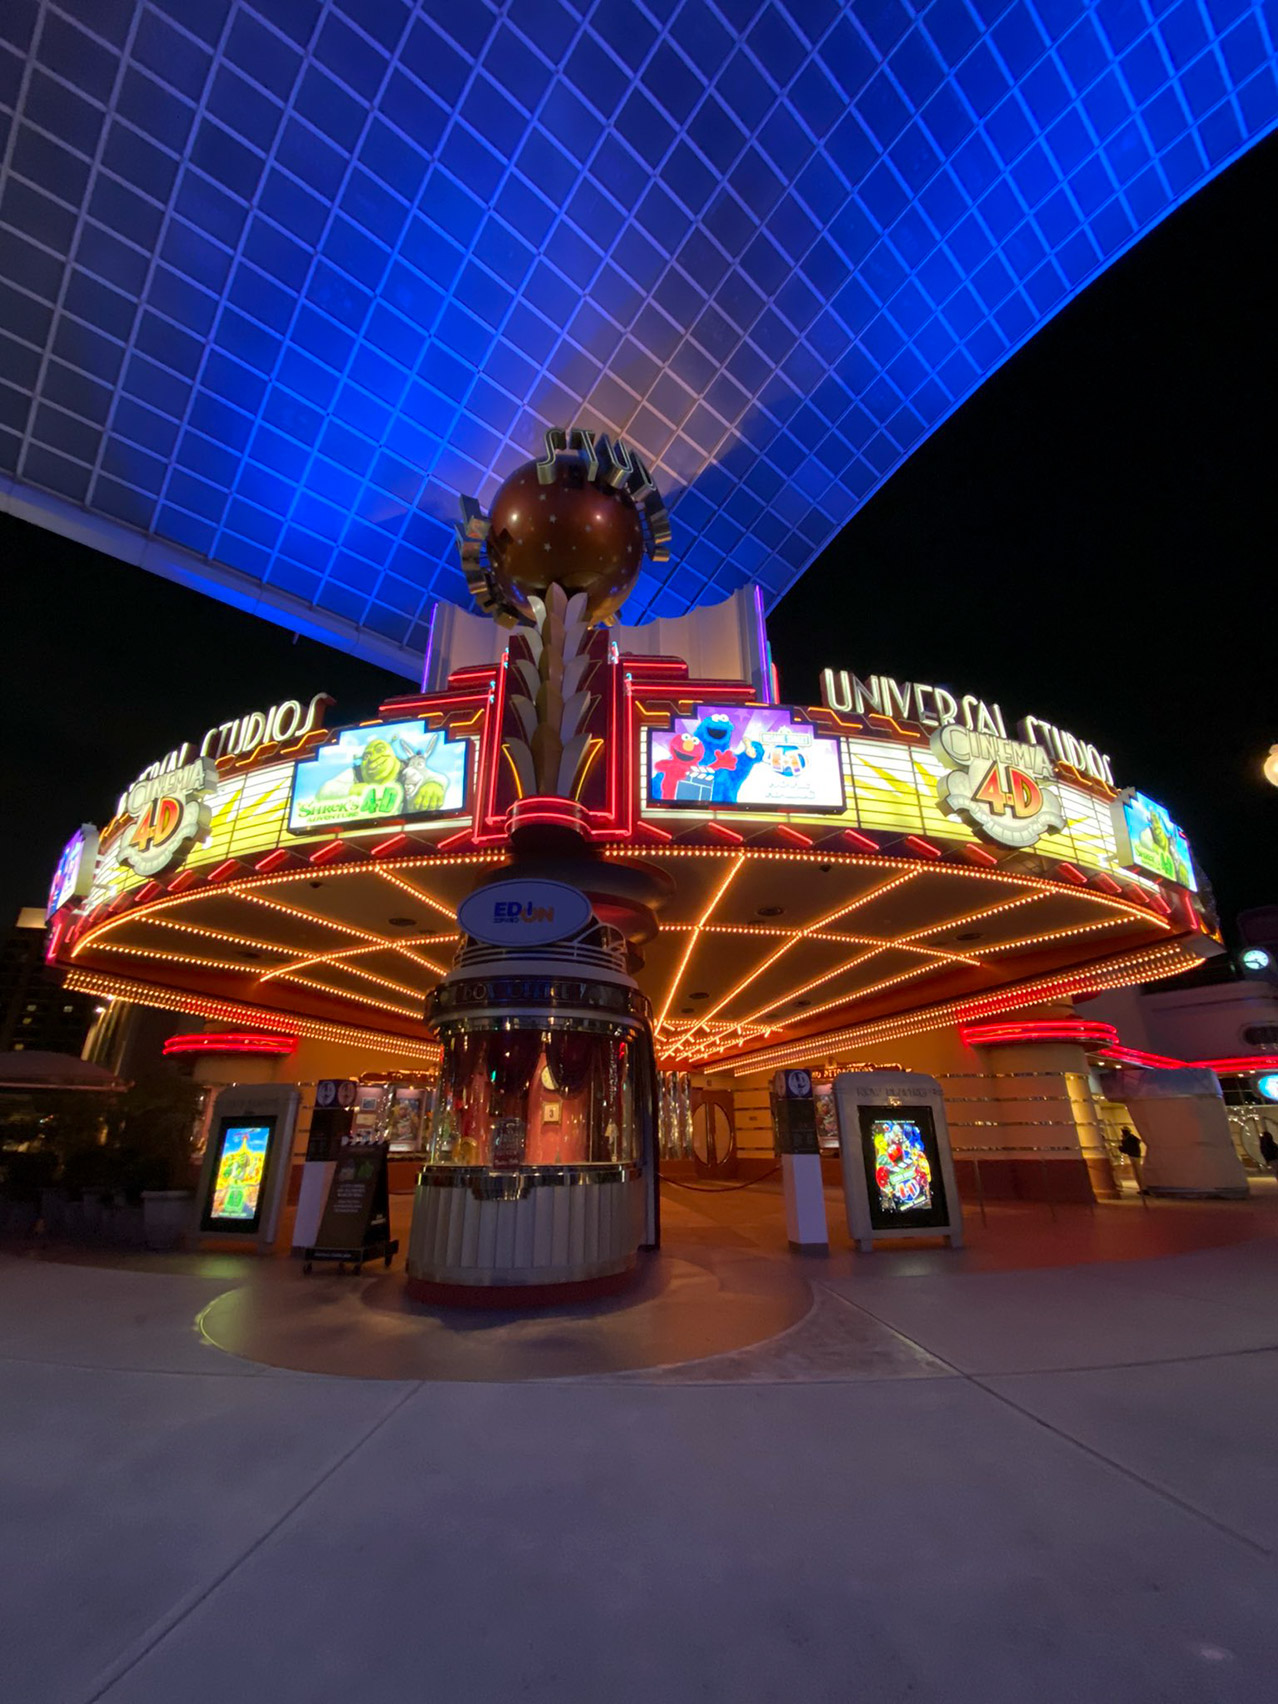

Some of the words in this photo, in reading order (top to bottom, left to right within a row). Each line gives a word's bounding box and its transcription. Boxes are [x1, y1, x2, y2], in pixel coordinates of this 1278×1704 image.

[200, 692, 334, 759] STUDIOS
[821, 668, 1008, 738] UNIVERSAL
[1019, 715, 1115, 786] STUDIOS
[939, 723, 1054, 780] CINEMA
[127, 757, 206, 817] CINEMA
